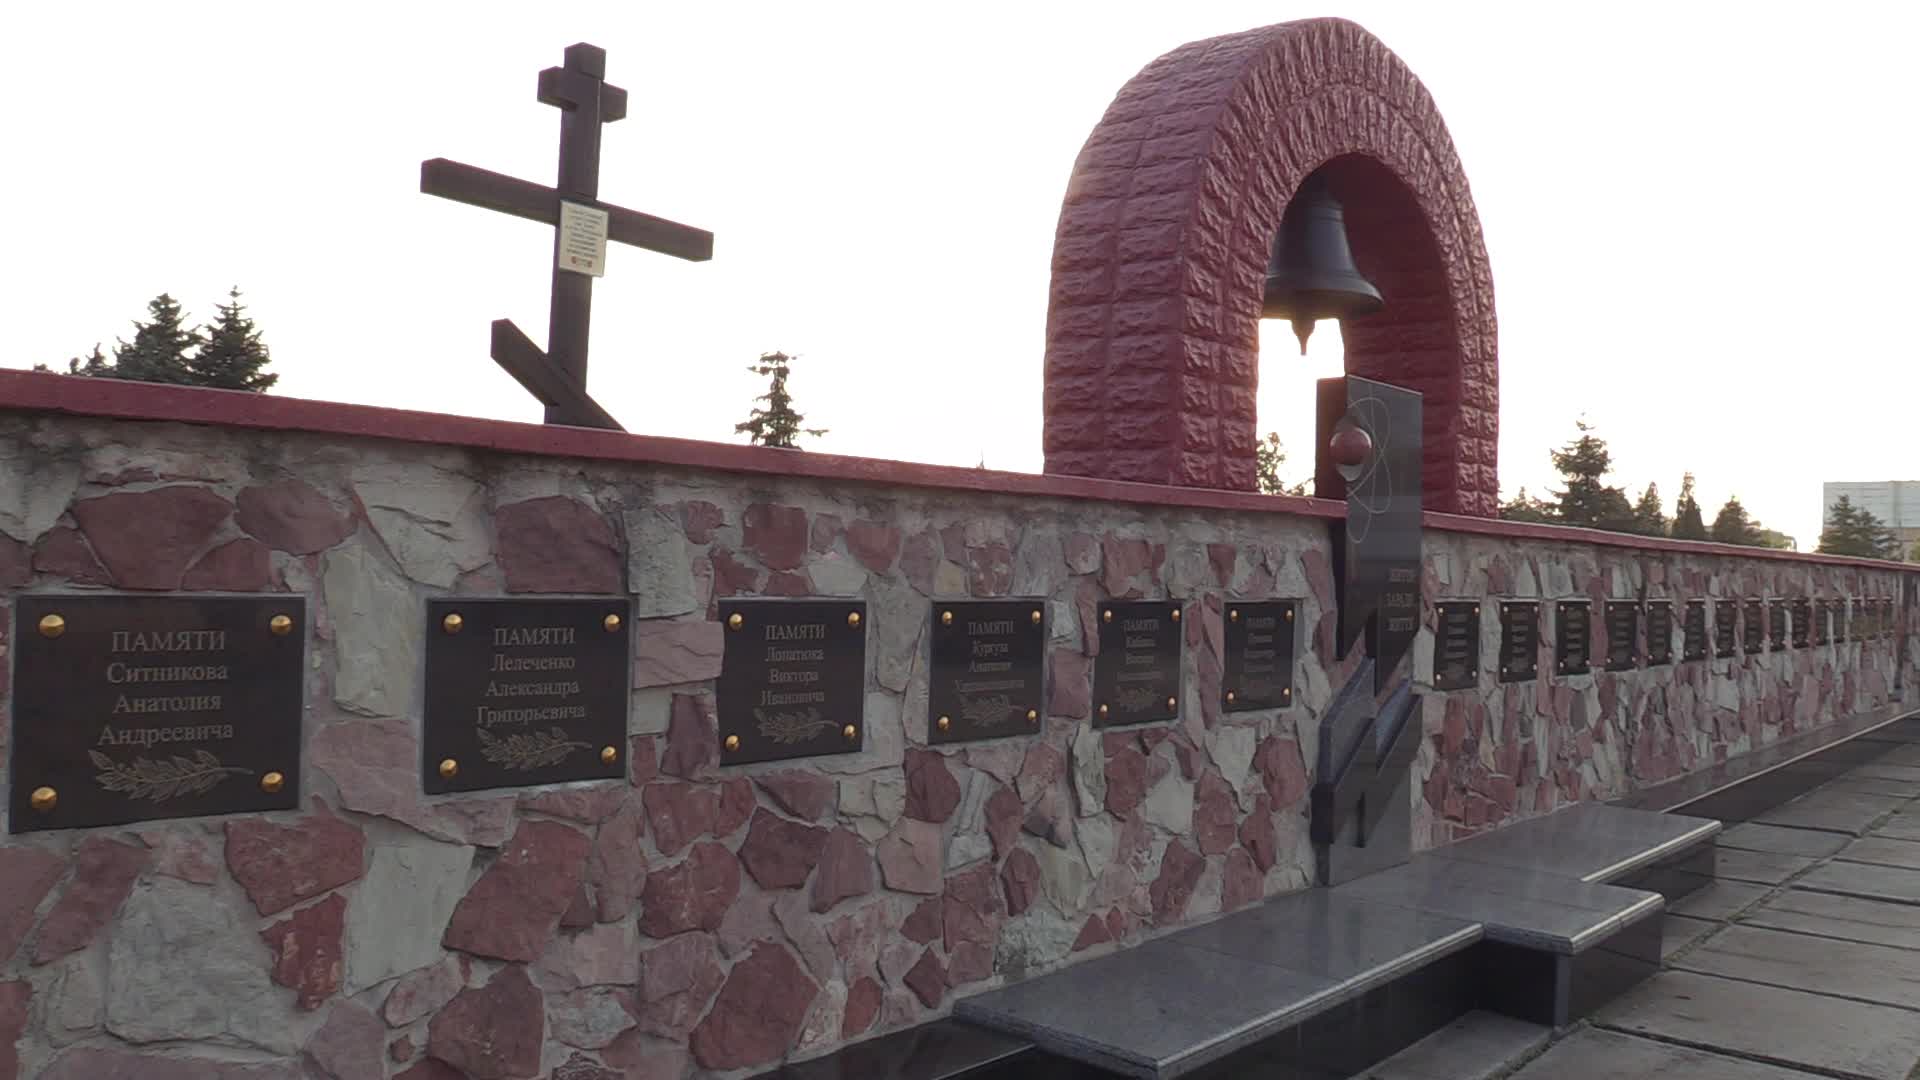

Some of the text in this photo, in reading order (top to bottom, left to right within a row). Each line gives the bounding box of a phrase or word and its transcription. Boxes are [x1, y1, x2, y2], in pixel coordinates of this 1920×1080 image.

[494, 627, 576, 646] ПАМЯТИ
[766, 624, 825, 641] ПАМЯТИ
[967, 621, 1015, 635] ПАМЯТИ
[112, 631, 225, 652] ПАМЯТИ
[107, 662, 228, 683] Ситникова
[490, 654, 576, 672] Лелеченко
[485, 680, 581, 699] Александра
[112, 694, 221, 714] Анатолия
[477, 705, 585, 727] Григорьевича
[97, 724, 233, 748] Андреевича
